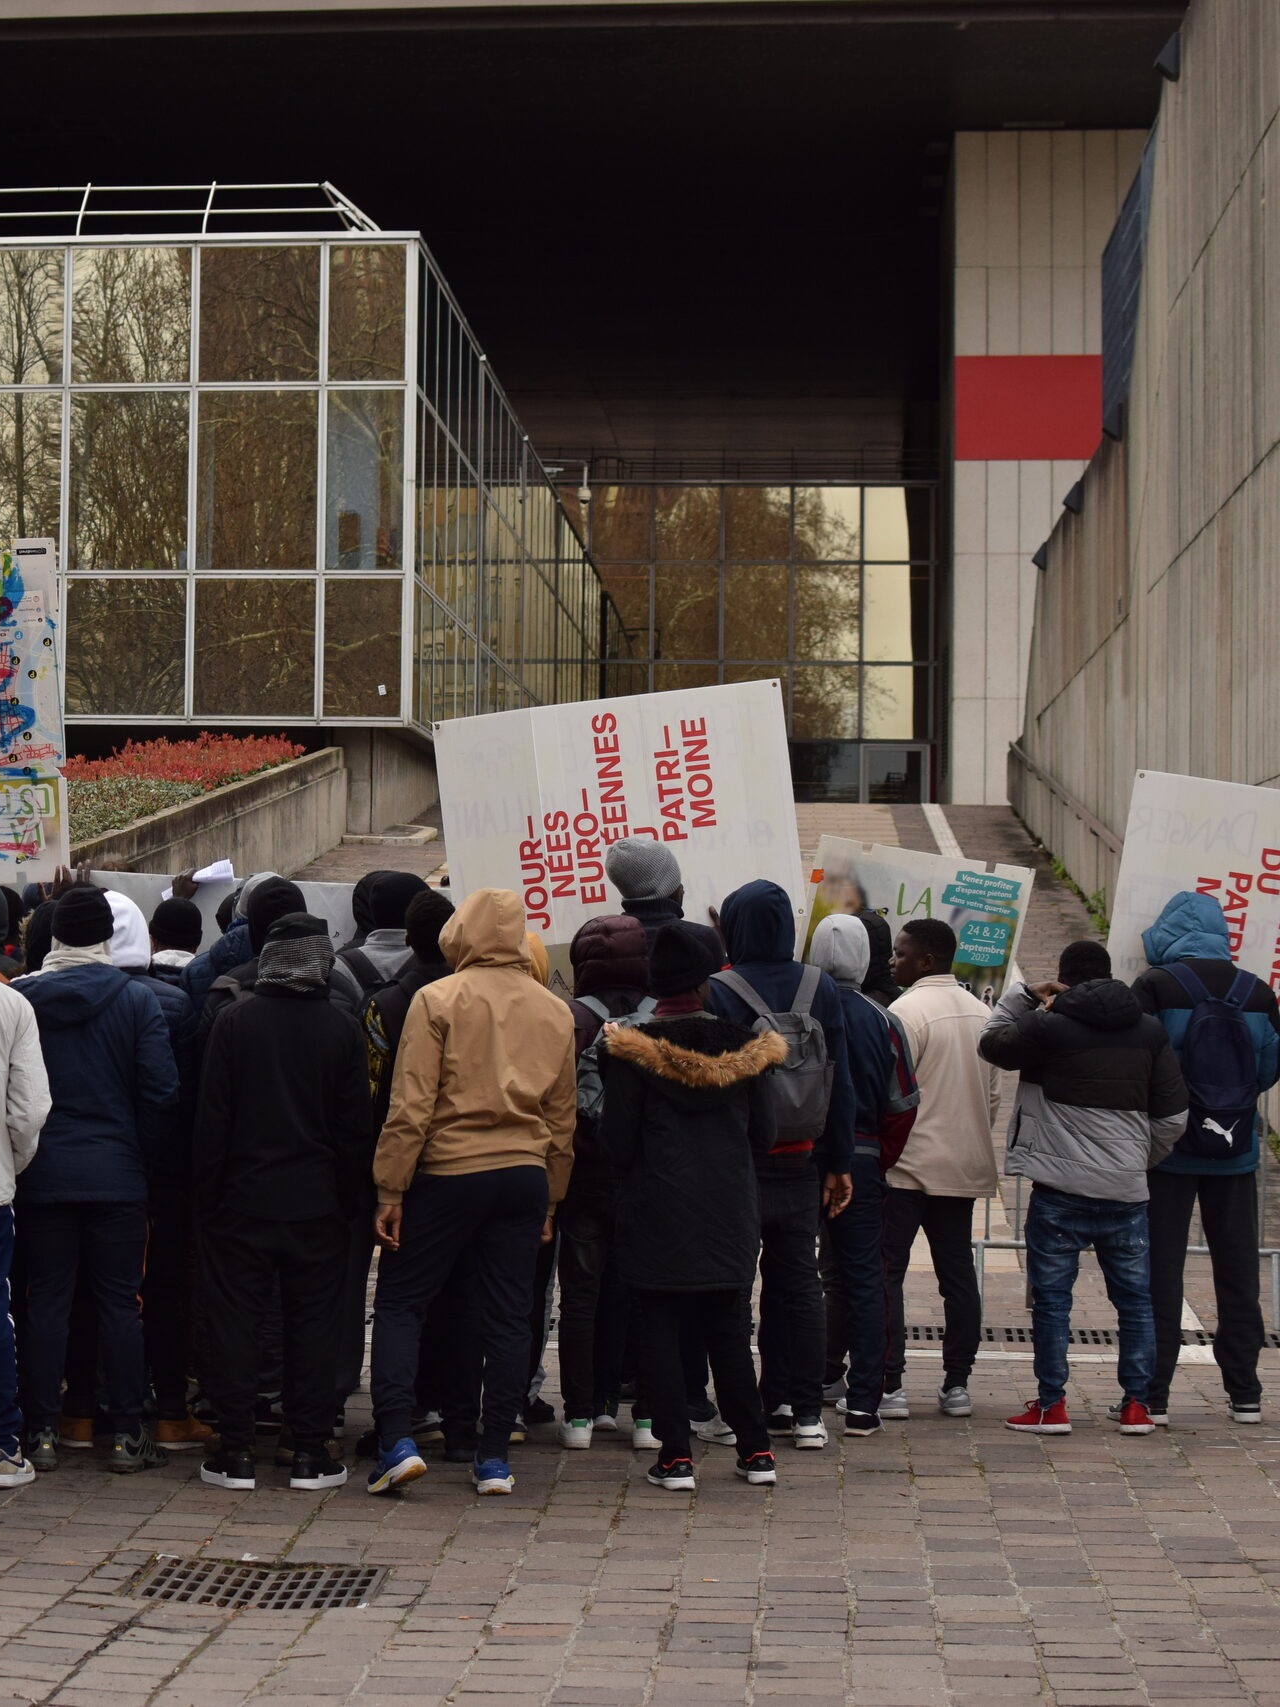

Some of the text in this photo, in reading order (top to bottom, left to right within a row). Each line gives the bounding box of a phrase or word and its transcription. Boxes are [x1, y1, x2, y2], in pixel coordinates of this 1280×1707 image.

[680, 717, 717, 828] MOINE
[543, 810, 577, 898] NÉES
[962, 874, 1015, 891] Venez profiter
[955, 886, 987, 897] d'espaces
[896, 883, 932, 919] LA
[949, 896, 1011, 914] dans votre quartier
[967, 924, 1006, 939] 24 & 25
[959, 941, 1006, 956] Septembre
[970, 952, 990, 962] 2022
